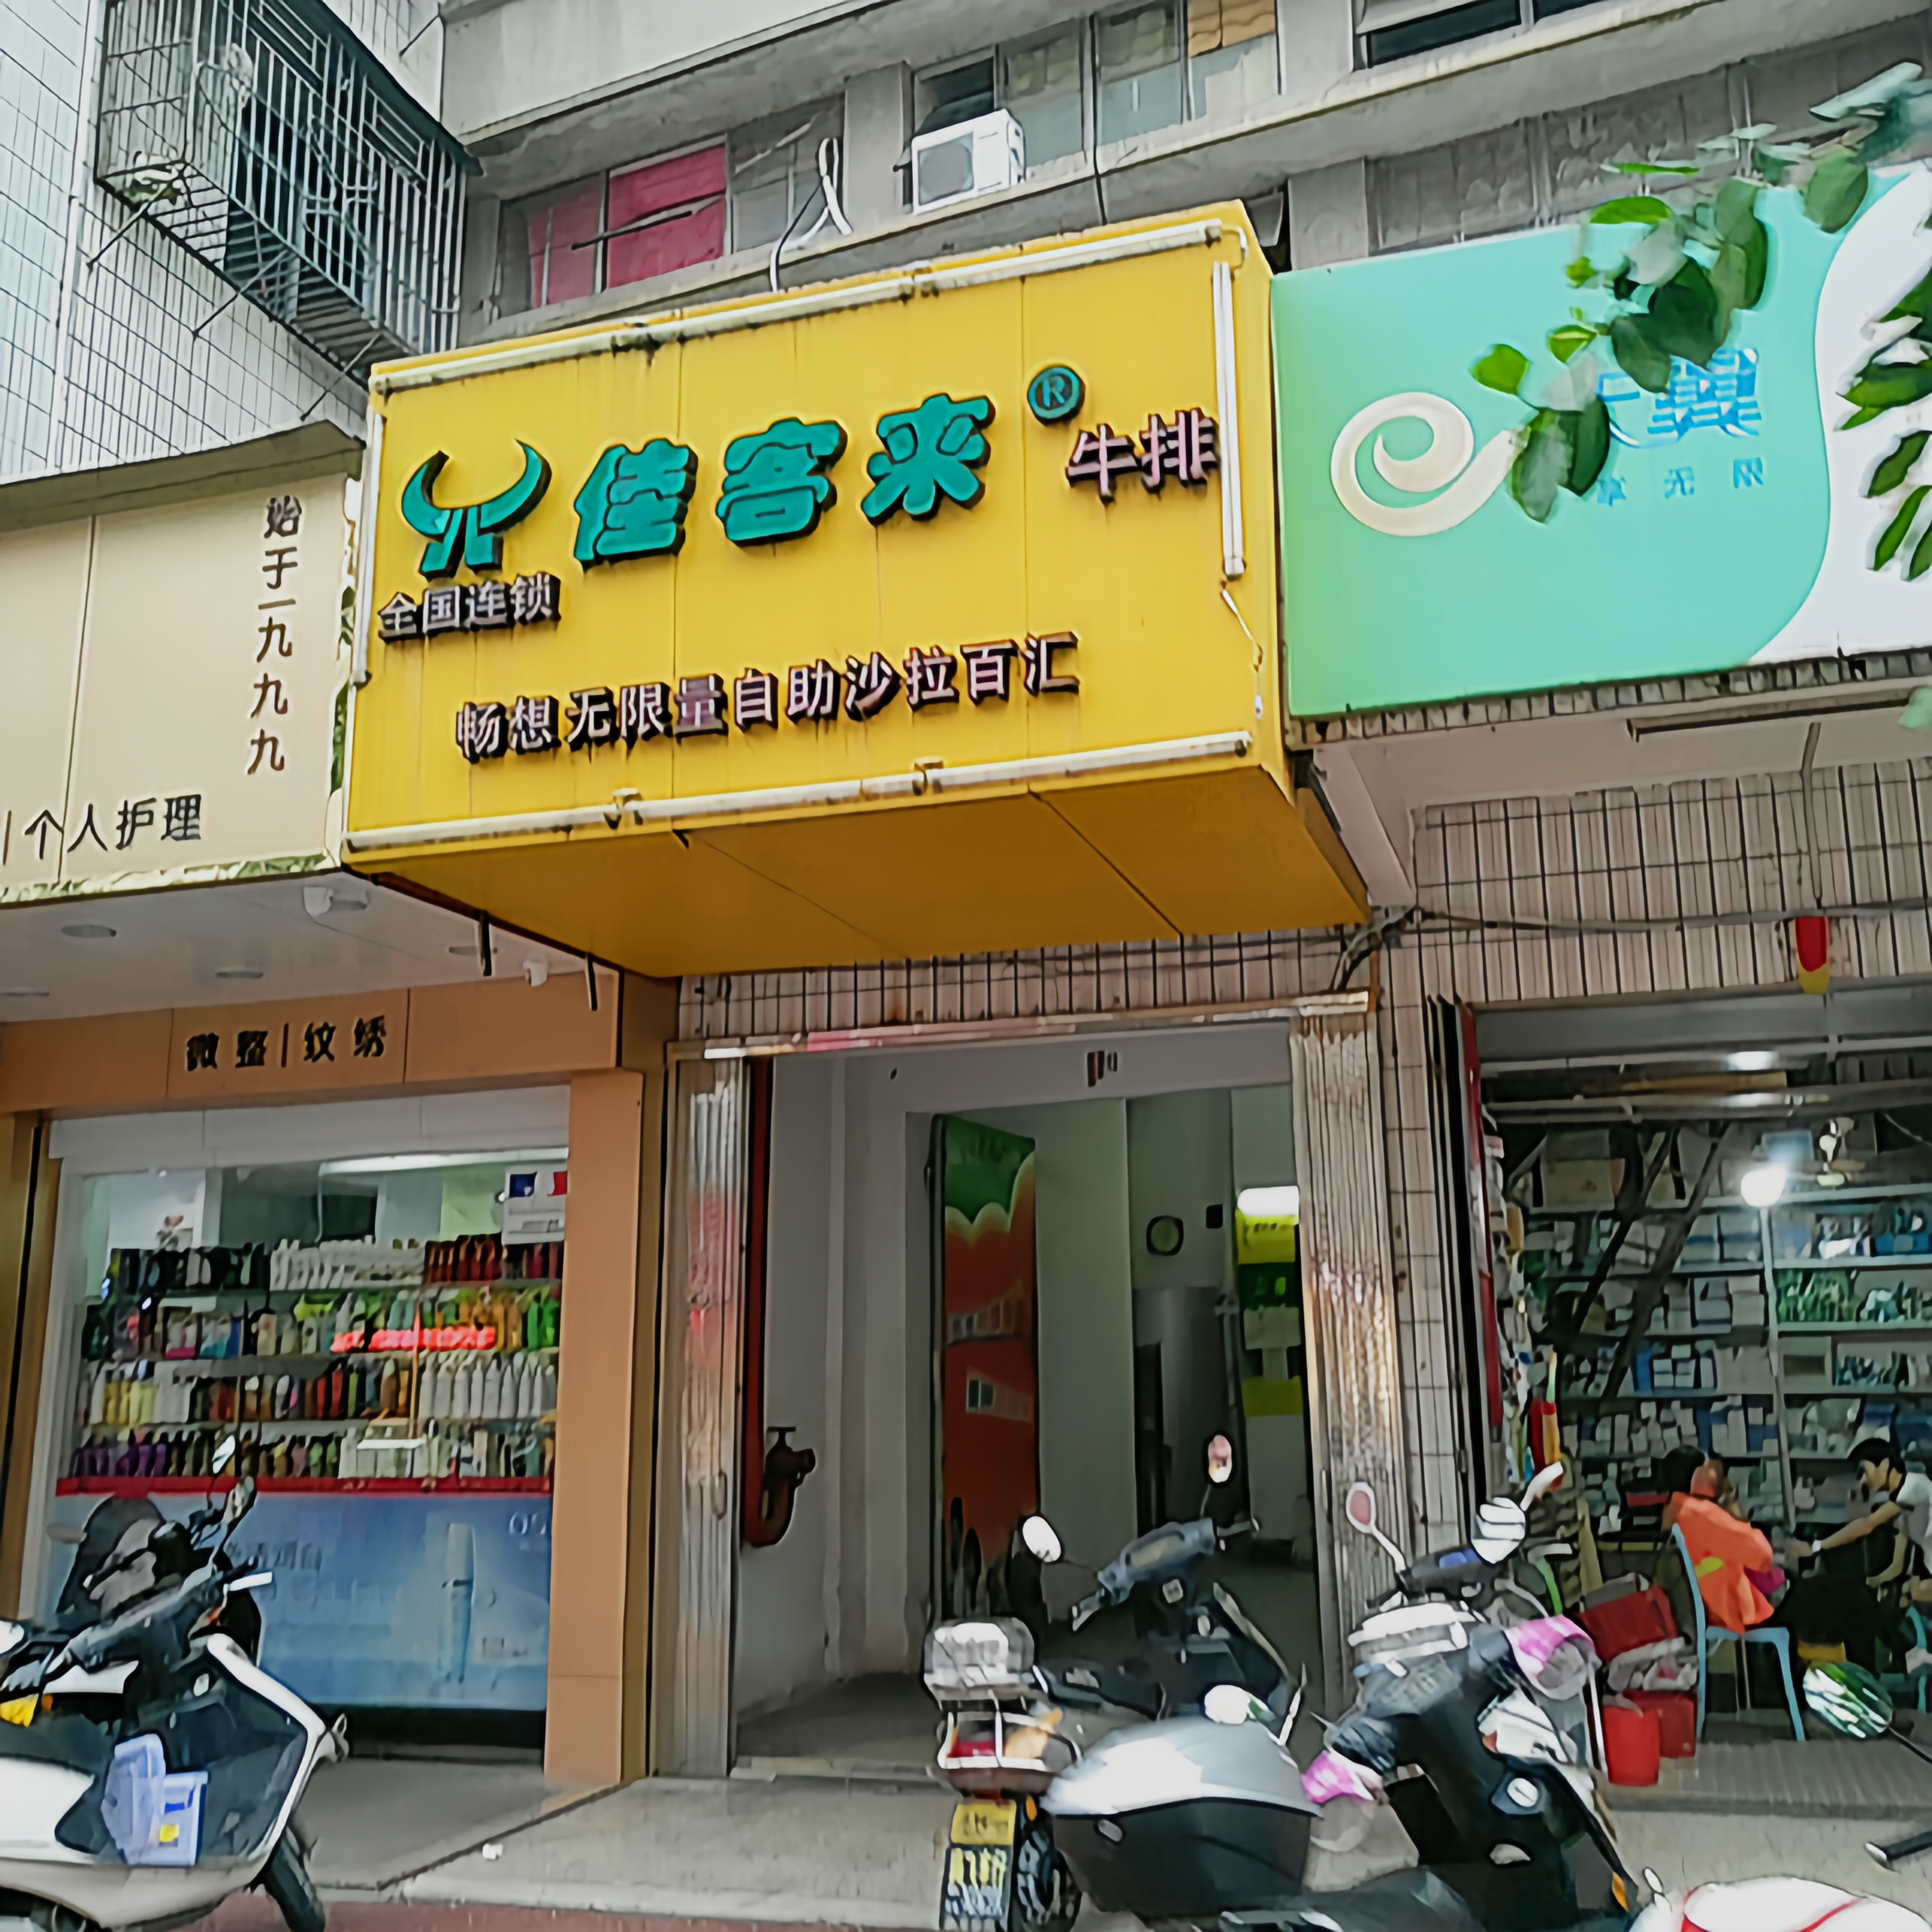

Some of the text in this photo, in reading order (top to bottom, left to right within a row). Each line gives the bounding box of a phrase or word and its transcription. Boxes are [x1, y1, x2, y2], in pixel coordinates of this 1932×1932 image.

[574, 393, 995, 570] 佳客来
[1065, 408, 1219, 504] 牛排
[247, 495, 302, 775] 始于一九九九
[378, 571, 561, 645] 全国连锁
[455, 631, 1079, 764] 畅想无限量自助沙拉百汇
[24, 794, 202, 860] 个人护理
